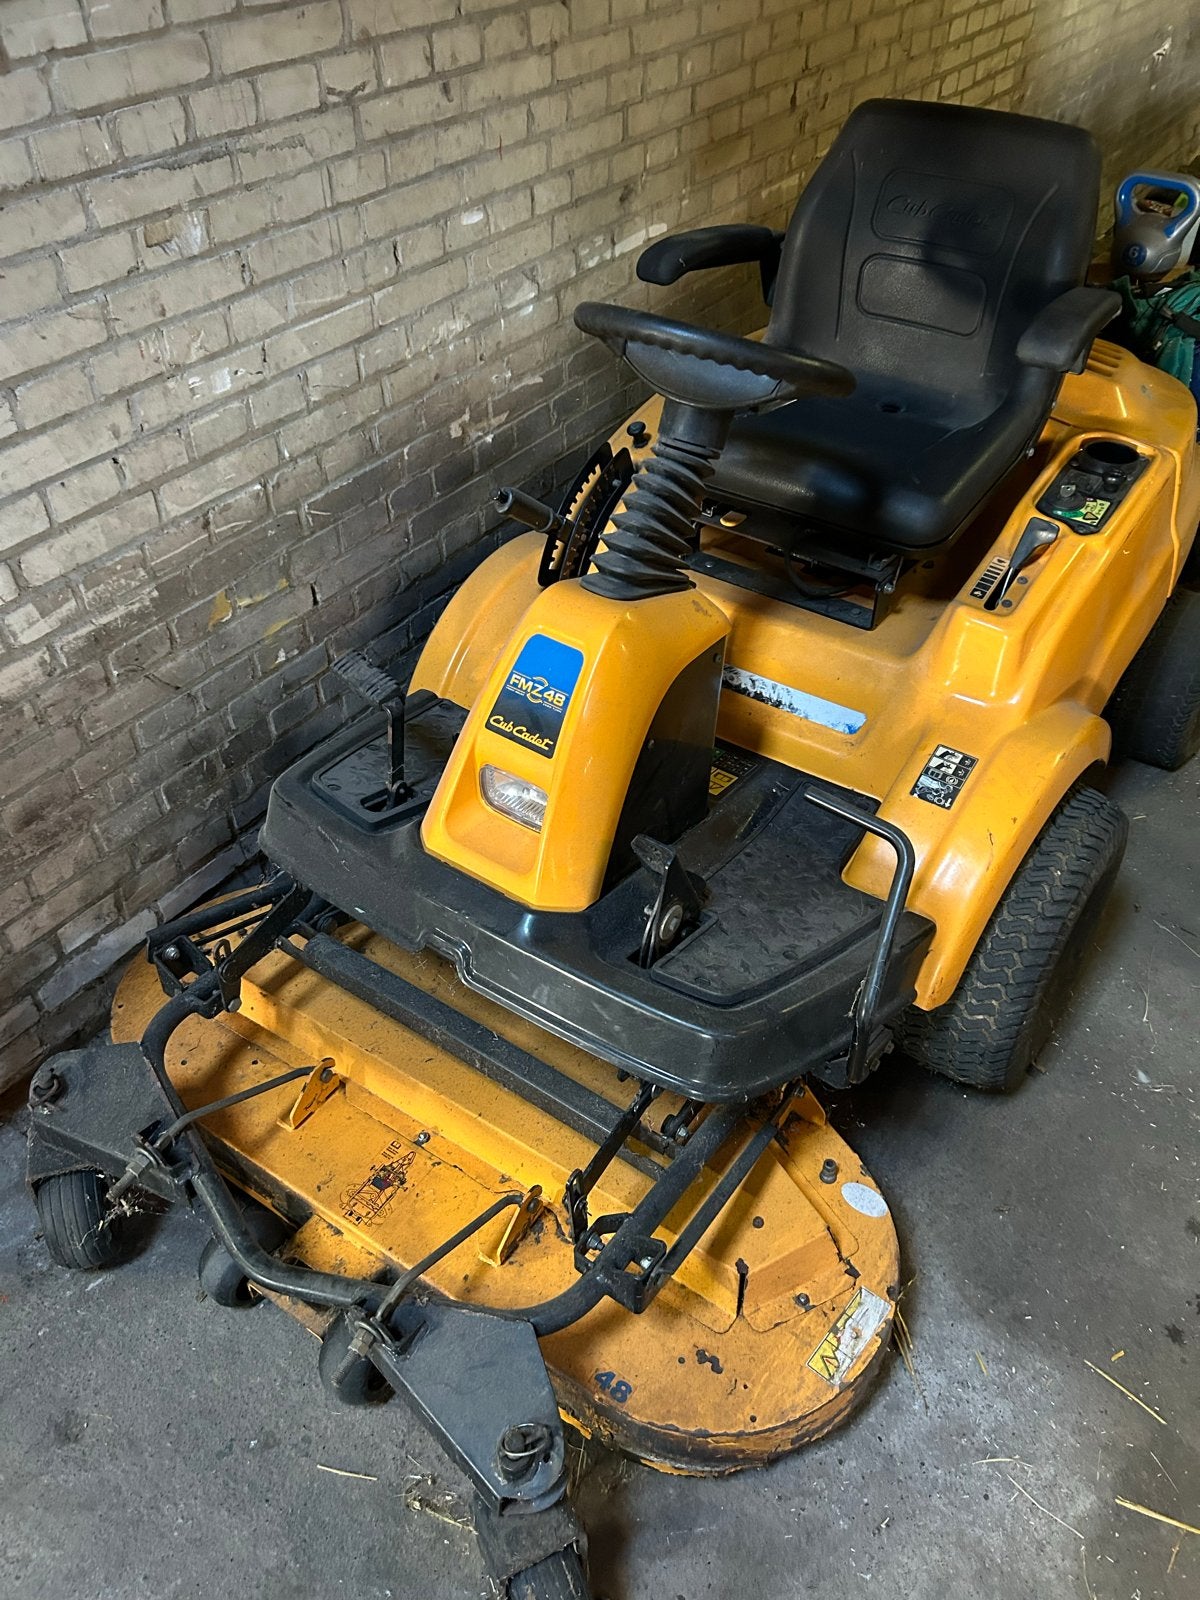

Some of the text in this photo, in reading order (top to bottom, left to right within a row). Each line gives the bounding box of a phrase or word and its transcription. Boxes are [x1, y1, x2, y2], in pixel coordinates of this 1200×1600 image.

[489, 715, 554, 751] Cub Cadet
[594, 1370, 633, 1404] 48
